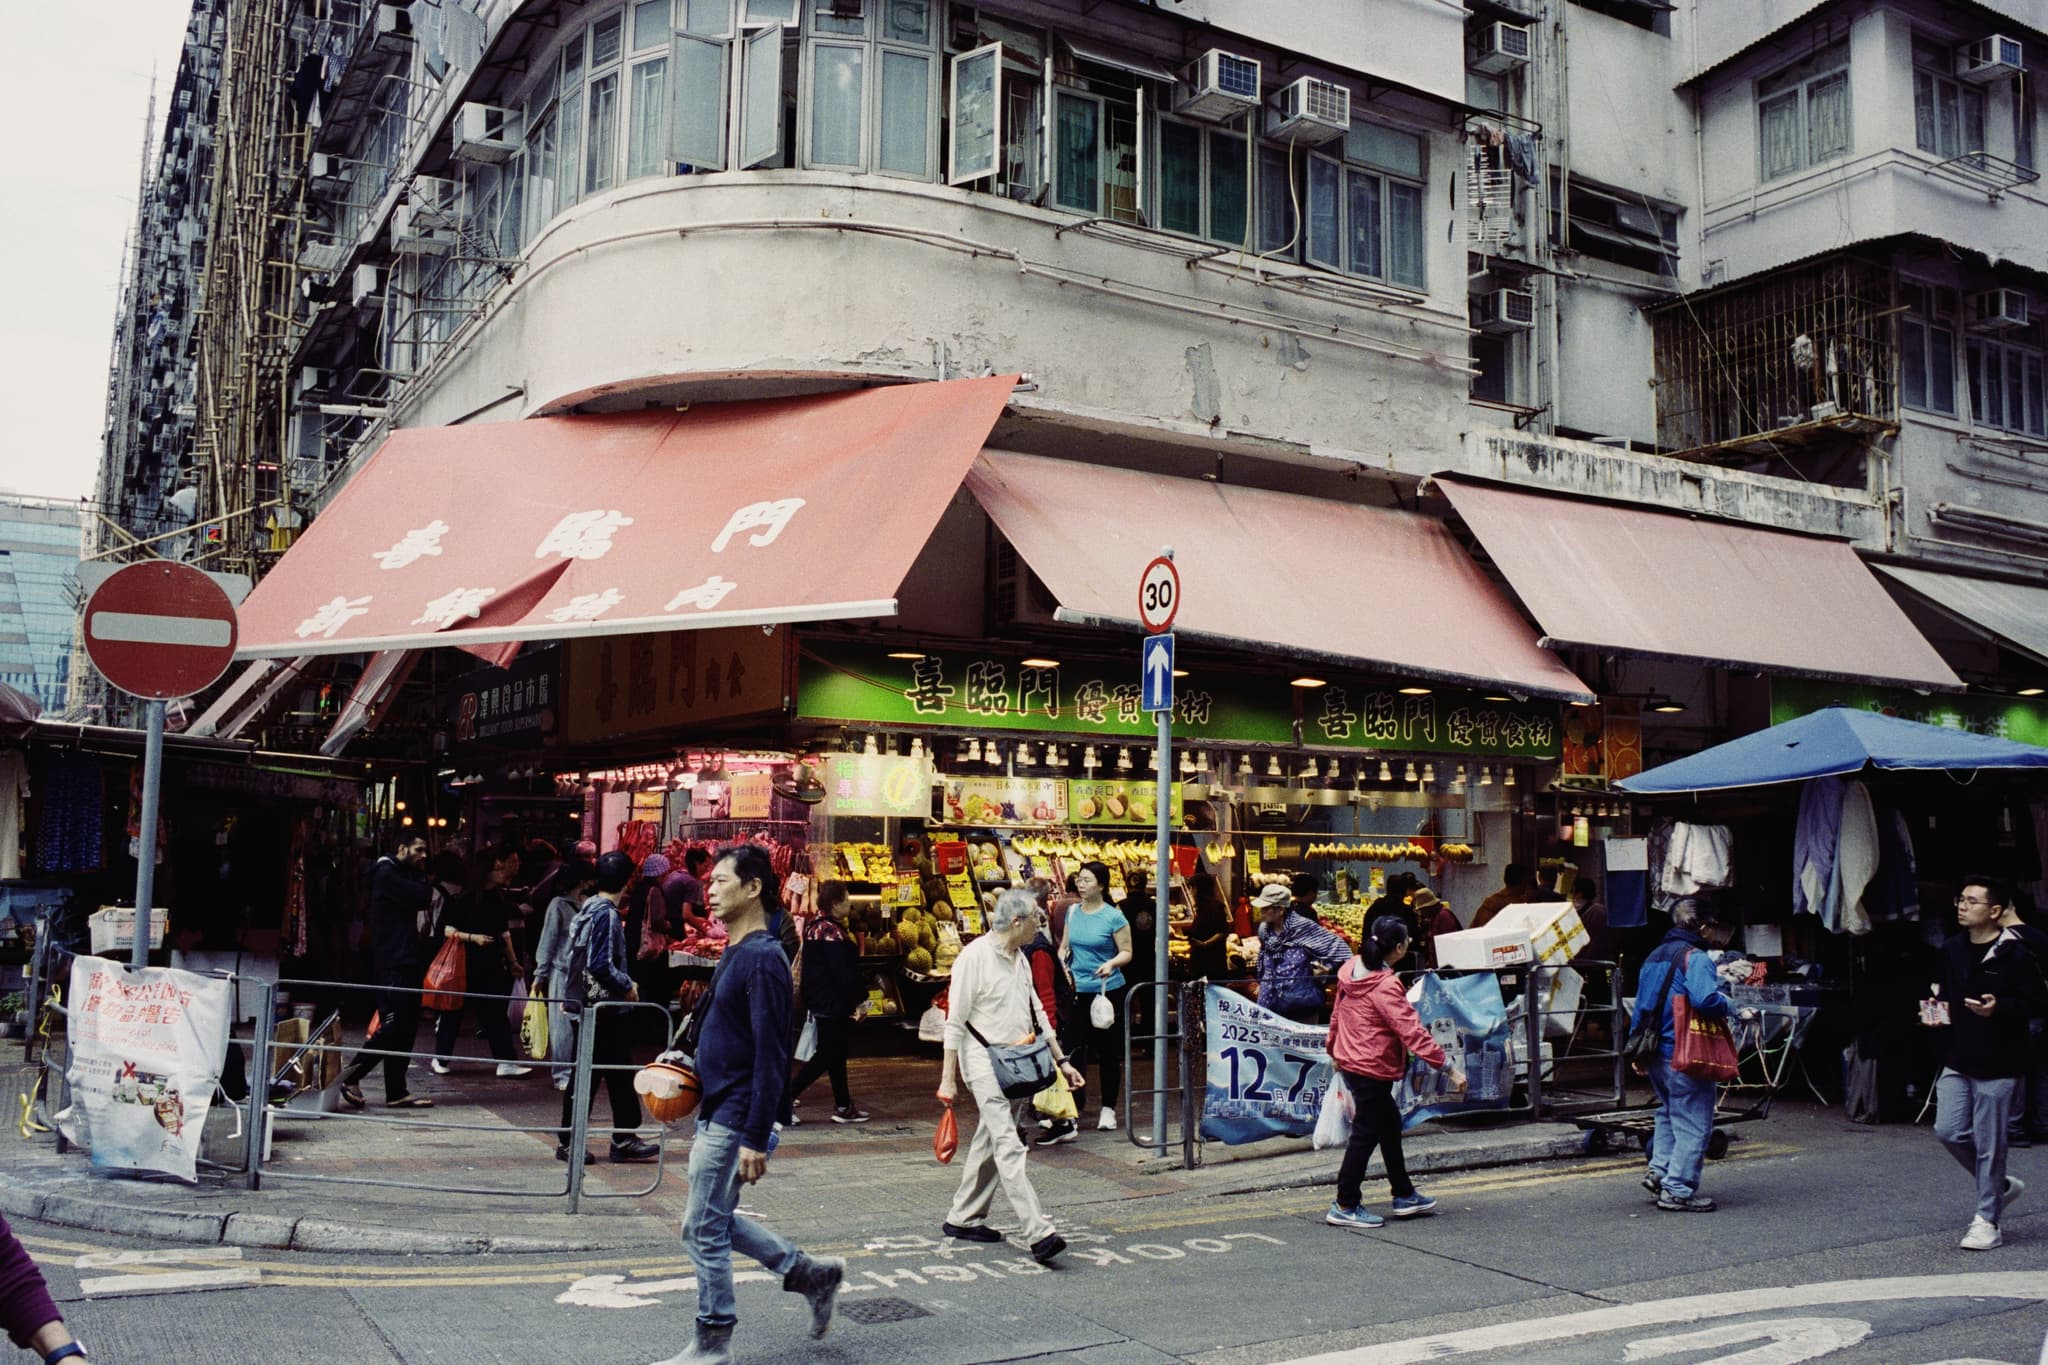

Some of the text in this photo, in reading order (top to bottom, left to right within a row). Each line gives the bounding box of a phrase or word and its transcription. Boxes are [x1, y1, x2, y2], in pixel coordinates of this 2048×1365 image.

[372, 496, 806, 570] 喜臨門
[1145, 579, 1172, 612] 30
[904, 655, 1214, 725] 喜臨門 優質材
[1318, 686, 1553, 748] 喜臨門 優質食材
[836, 1231, 1288, 1295] LOOK RIGHT
